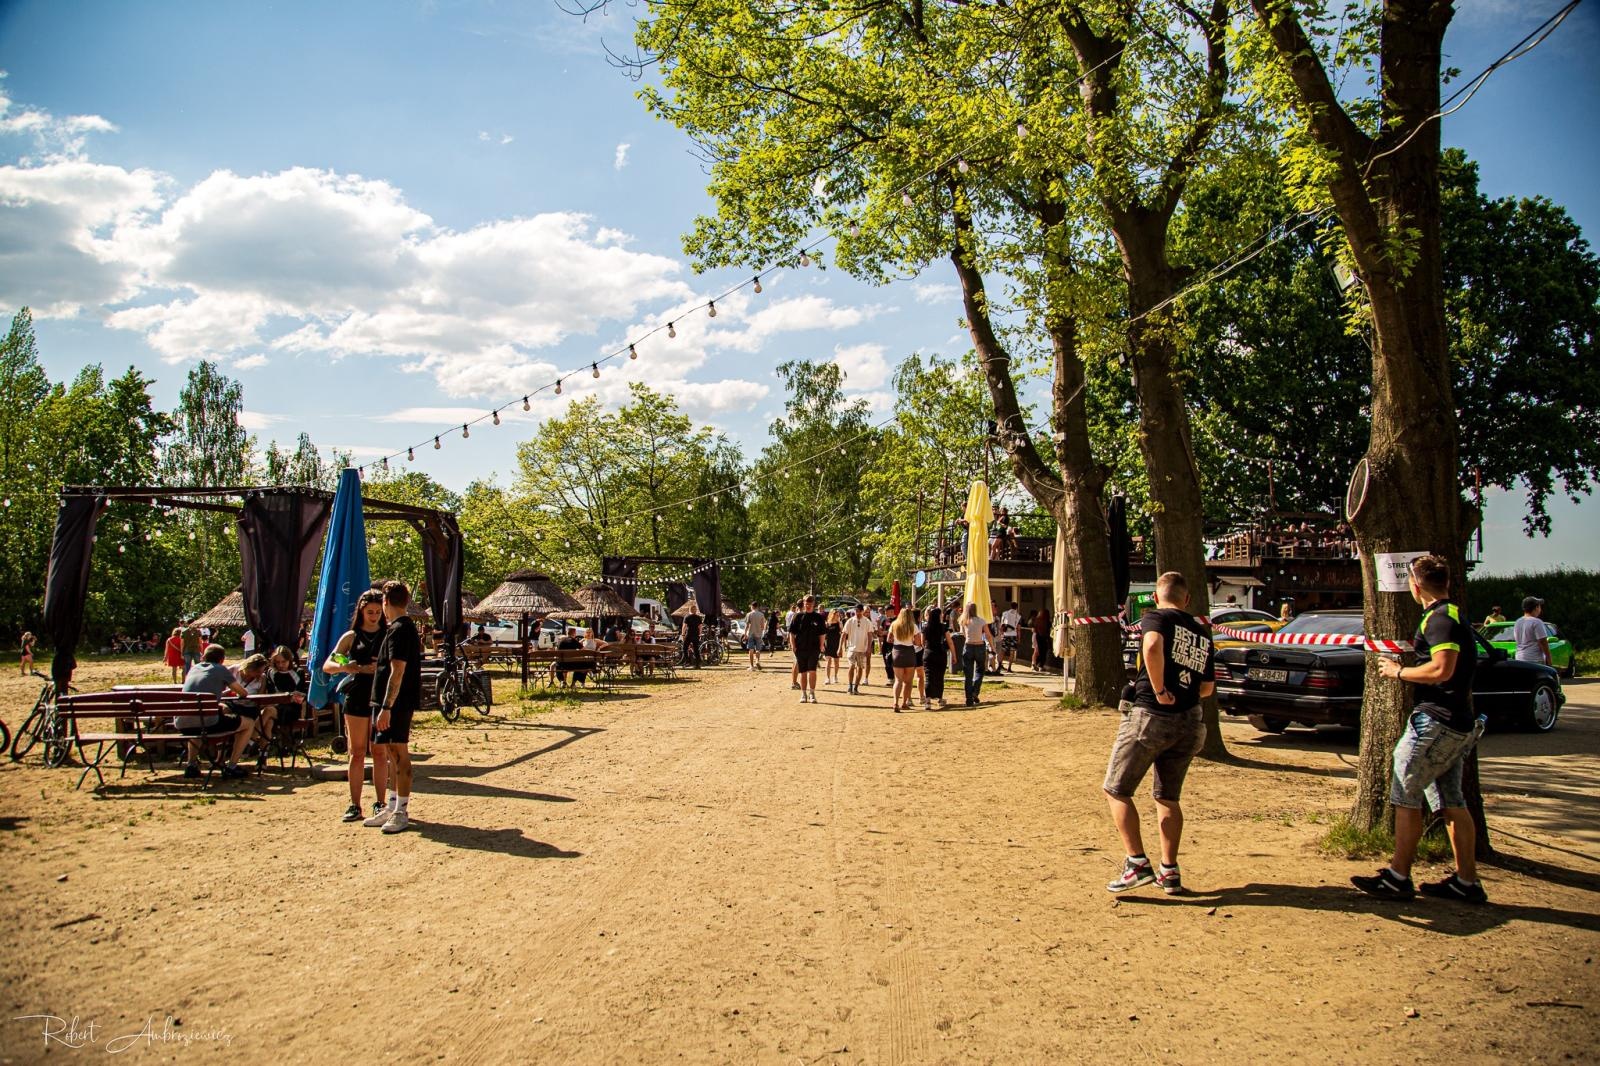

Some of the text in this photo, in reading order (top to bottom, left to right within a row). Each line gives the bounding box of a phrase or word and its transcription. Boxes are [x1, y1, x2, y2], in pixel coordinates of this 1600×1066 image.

[1174, 625, 1210, 651] BEST OF
[1172, 639, 1209, 663] THE BEST
[1248, 668, 1261, 678] SR
